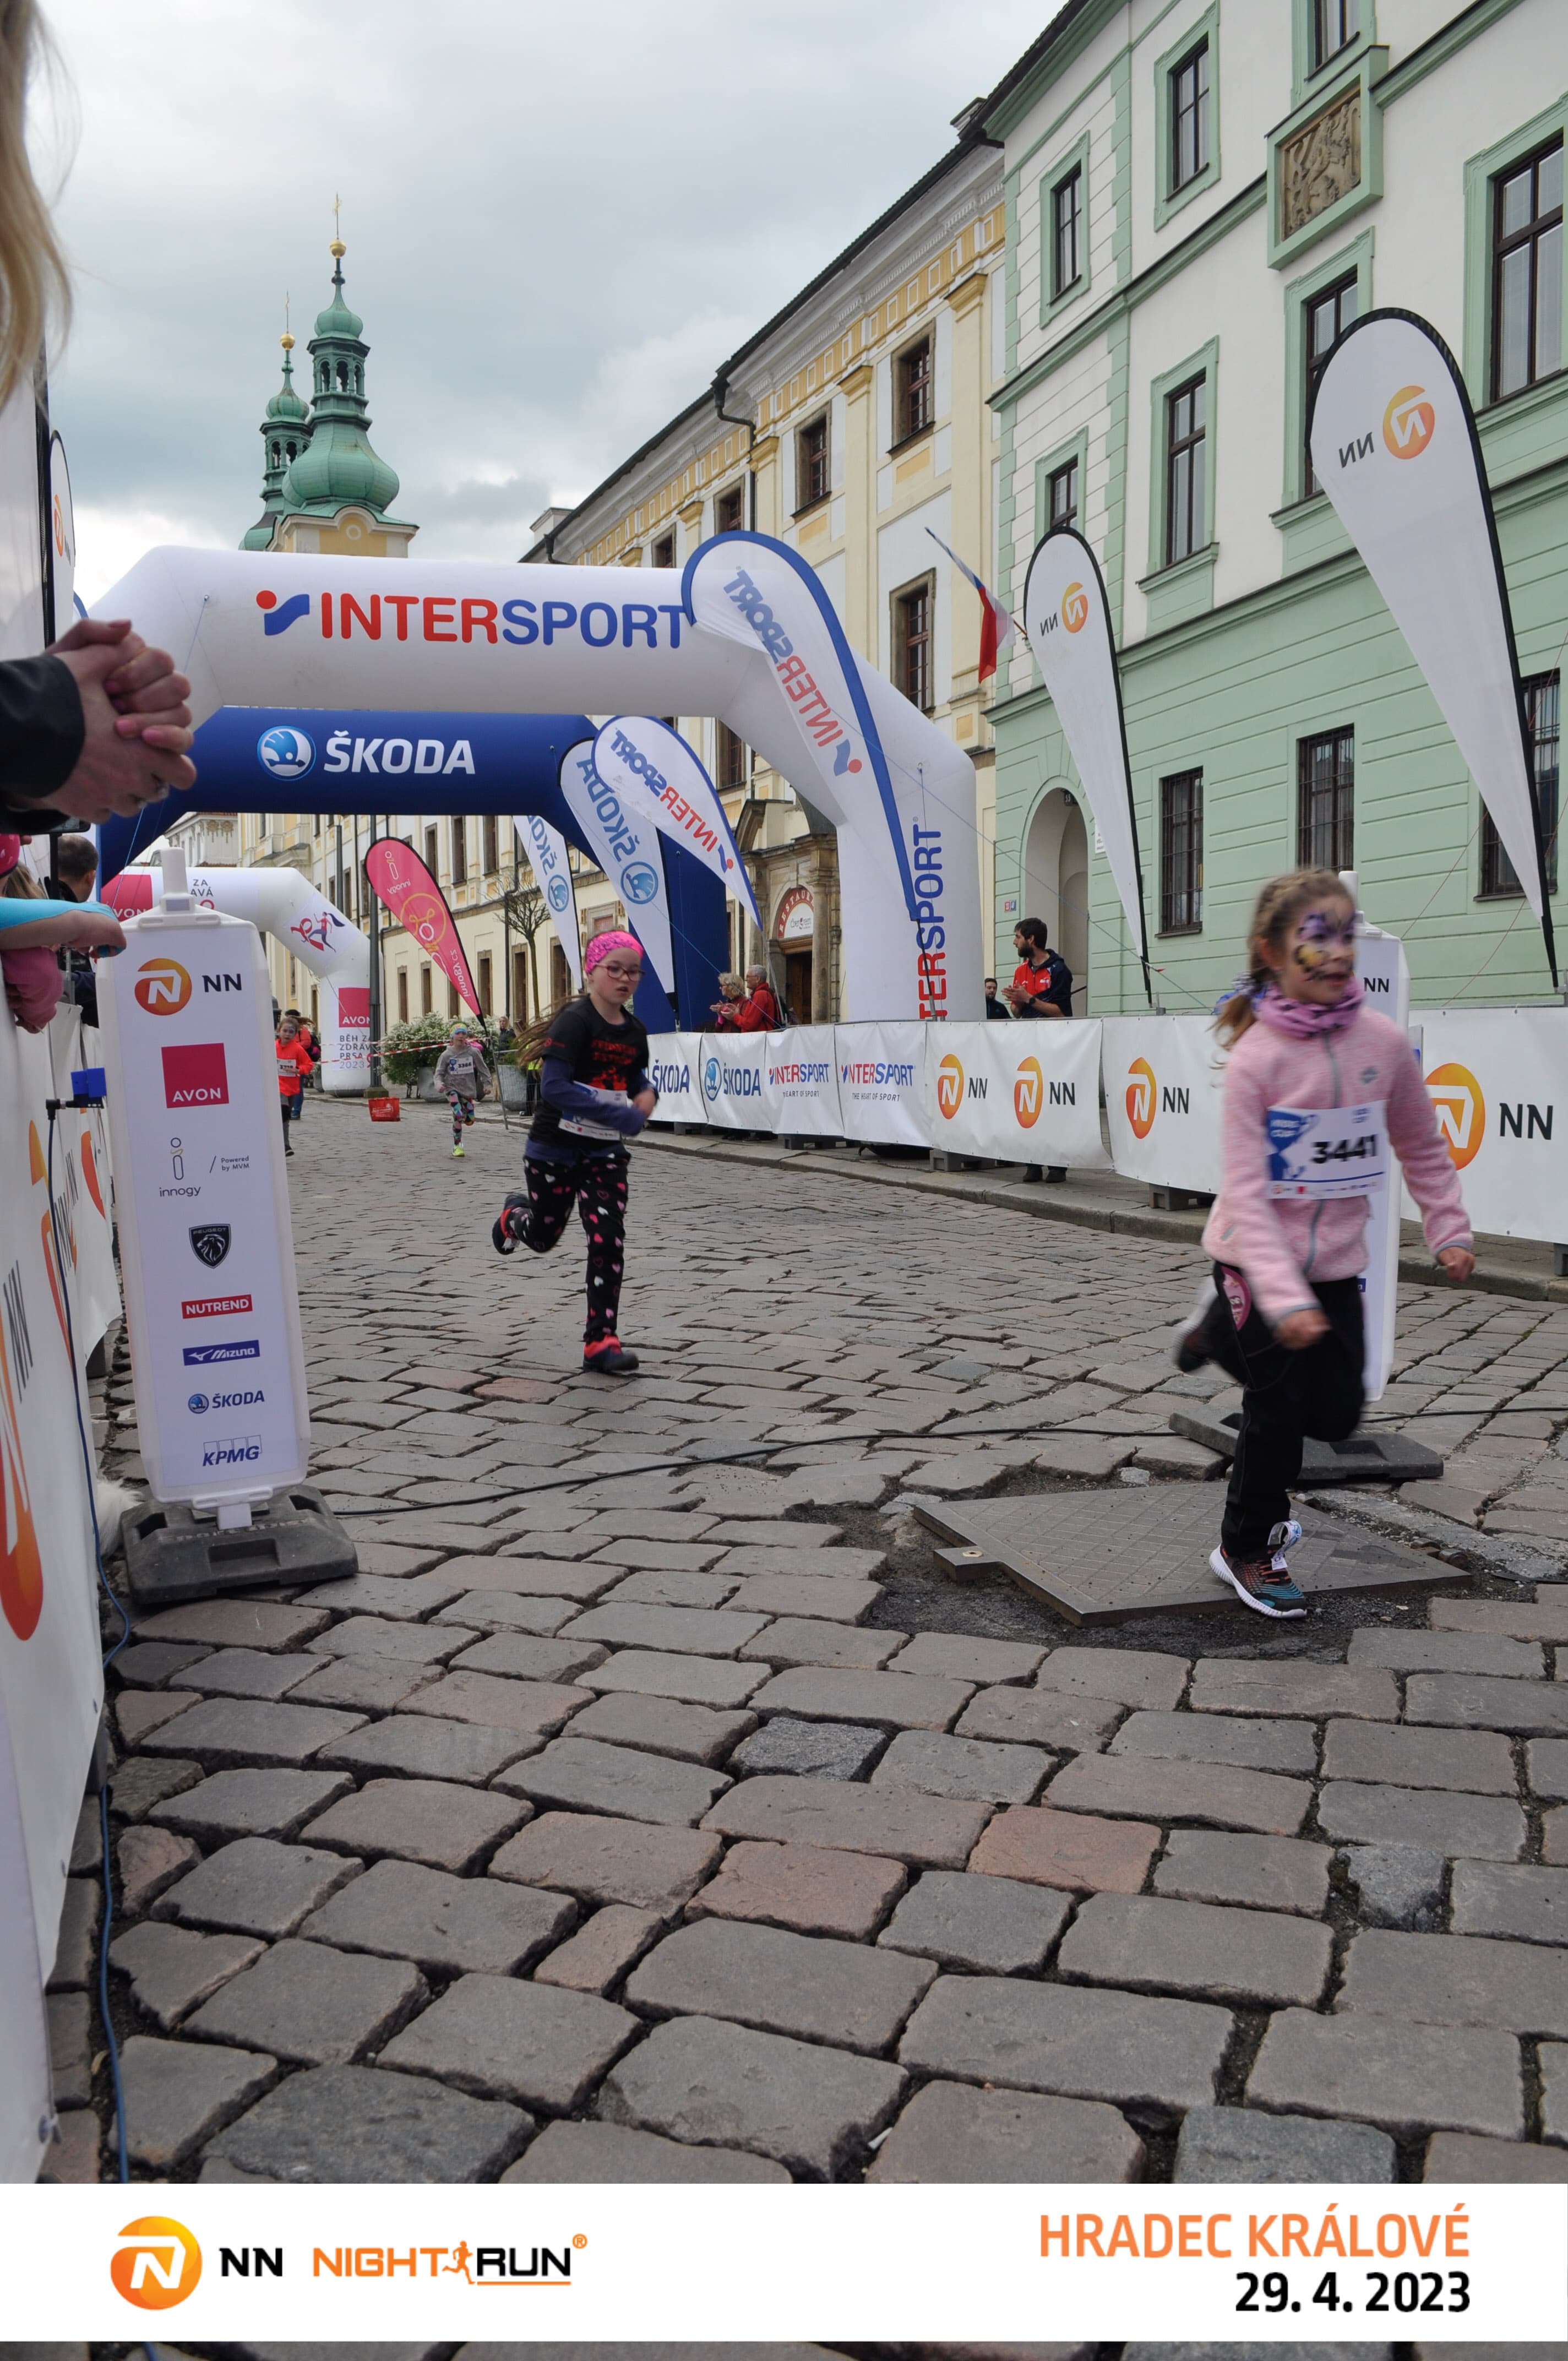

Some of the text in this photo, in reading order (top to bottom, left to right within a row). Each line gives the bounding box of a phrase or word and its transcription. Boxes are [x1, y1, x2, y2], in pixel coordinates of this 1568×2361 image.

[321, 592, 685, 649] INTERSPORT
[324, 730, 476, 775] ŠKODA
[190, 887, 214, 897] AVÁ
[913, 824, 948, 1019] TERSPORT
[202, 973, 242, 993] NN
[1364, 977, 1390, 993] NN
[340, 1034, 358, 1042] BĚH
[652, 1059, 689, 1094] ŠKODA
[723, 1063, 761, 1097] ŠKODA
[172, 1087, 222, 1103] AVON
[880, 1093, 900, 1102] SPORT
[968, 1077, 988, 1100] NN
[1049, 1081, 1075, 1106] NN
[1163, 1086, 1189, 1114] NN
[1500, 1102, 1554, 1140] NN
[159, 1187, 201, 1197] innogy
[186, 1299, 249, 1314] NUTREND
[212, 1390, 265, 1409] ŠKODA
[203, 1445, 260, 1466] KPMG
